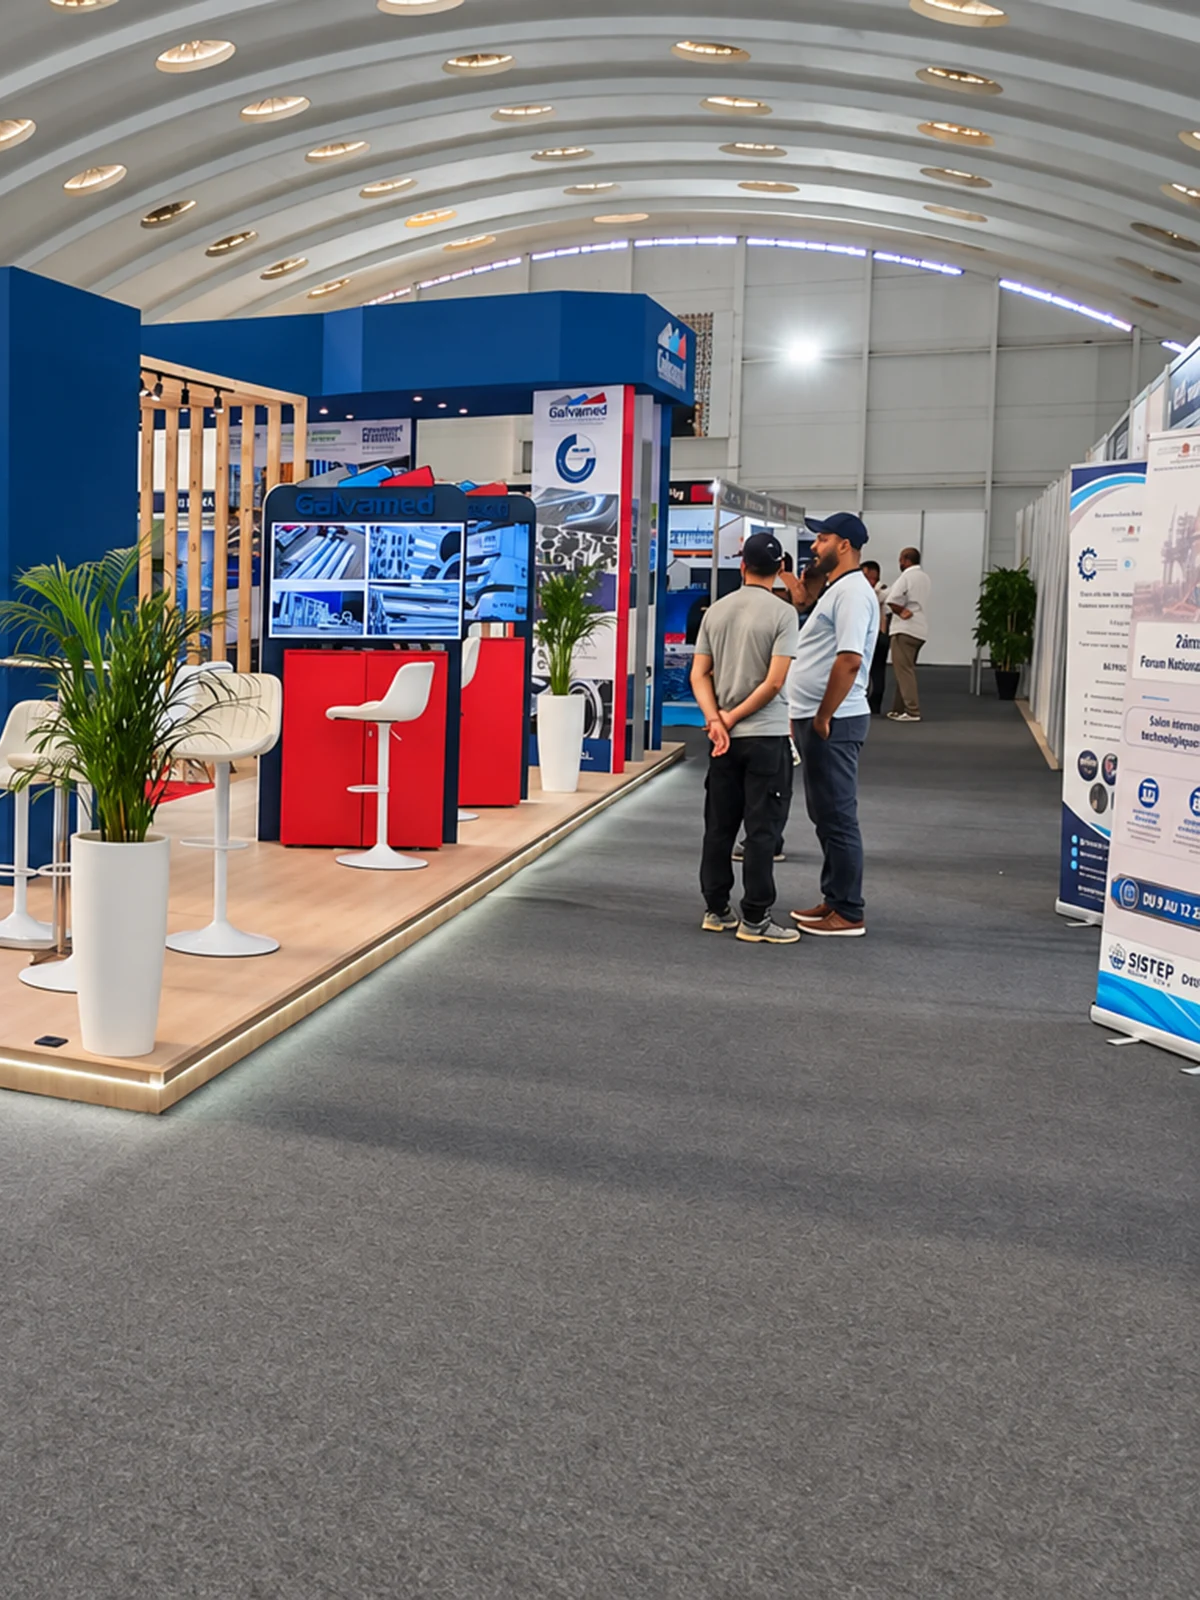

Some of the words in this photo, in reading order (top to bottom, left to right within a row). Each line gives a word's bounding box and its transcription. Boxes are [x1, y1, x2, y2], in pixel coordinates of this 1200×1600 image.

[549, 403, 607, 418] Galvamed
[295, 491, 436, 516] Galvamed
[1142, 892, 1156, 908] DU
[1156, 896, 1164, 910] 9
[1163, 899, 1178, 914] AU
[1180, 902, 1191, 918] 12
[1128, 952, 1174, 980] SISTEP
